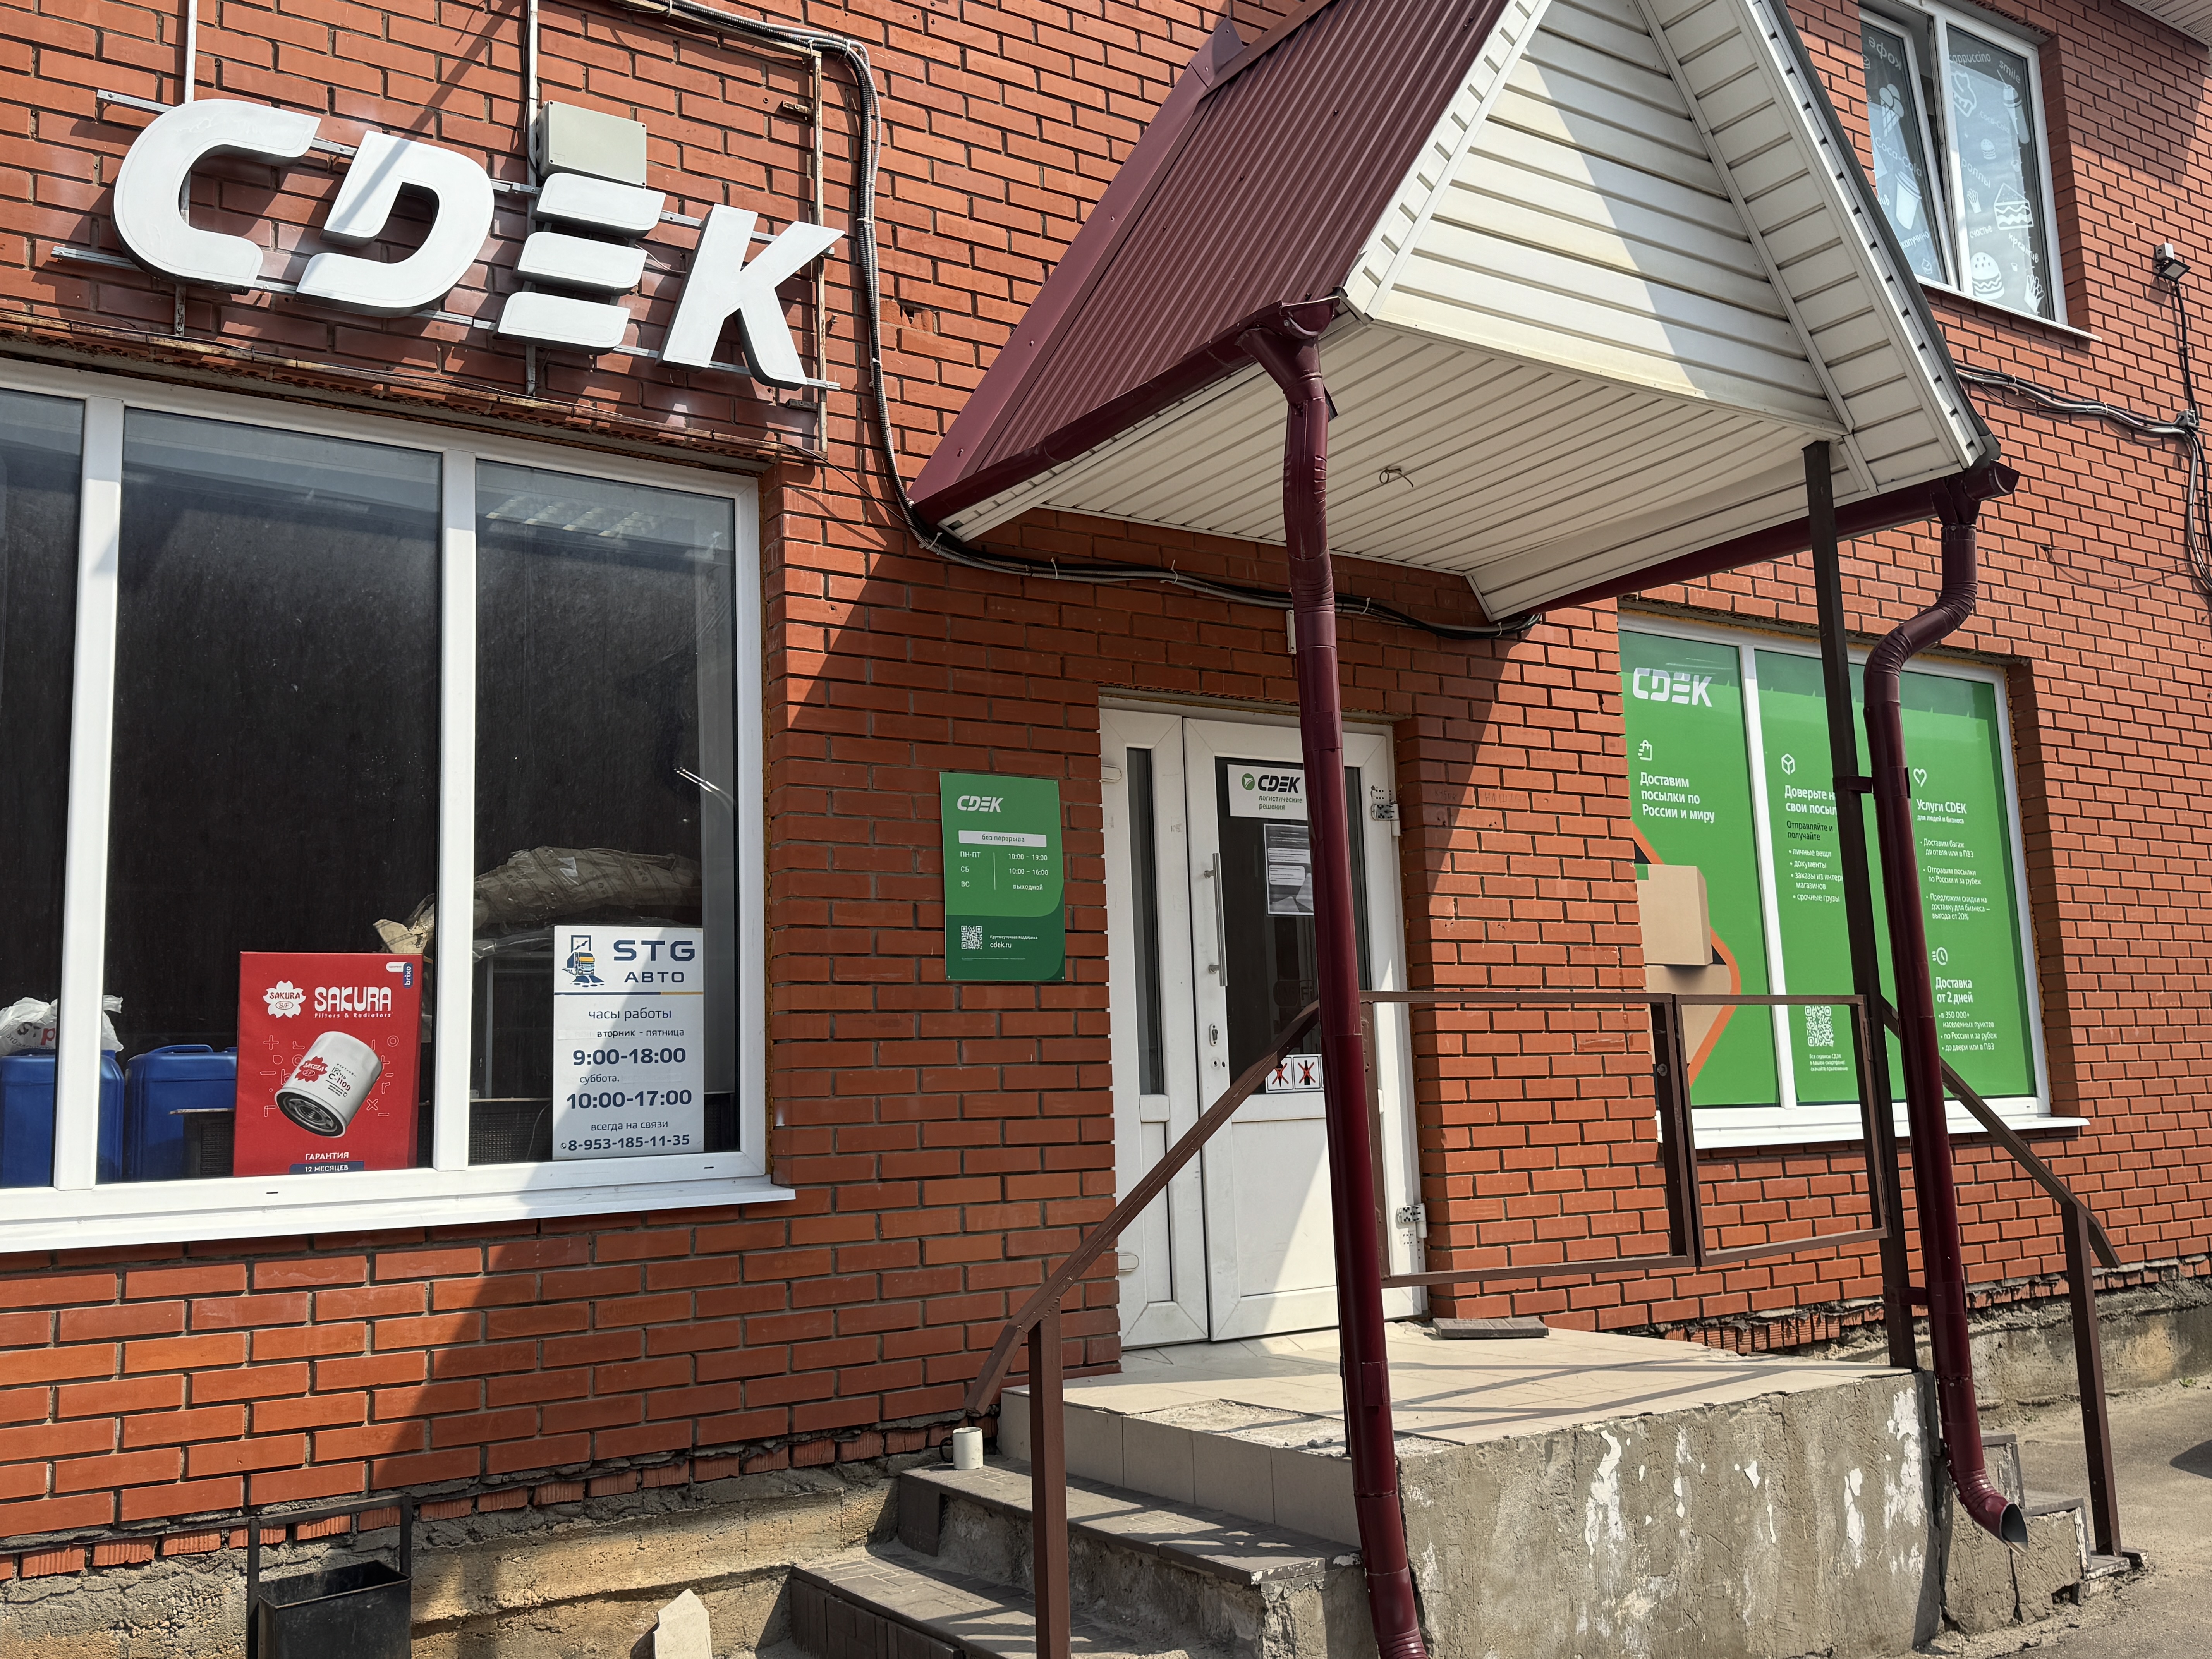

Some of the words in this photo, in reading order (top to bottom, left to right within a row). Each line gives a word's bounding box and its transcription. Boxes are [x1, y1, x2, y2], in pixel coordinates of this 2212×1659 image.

[1999, 60, 2021, 84] smile
[1875, 137, 1922, 177] Coca-Cola
[1961, 158, 1991, 189] роллы
[1969, 225, 1993, 239] счастье
[112, 98, 845, 390] CDEK
[1900, 231, 1930, 249] капучино
[2008, 232, 2039, 263] креатив
[1632, 667, 1712, 707] CDEK
[1258, 775, 1301, 793] CDEK
[1640, 772, 1689, 788] Доставим
[1641, 790, 1685, 803] посылки
[1688, 795, 1700, 804] по
[1784, 785, 1827, 801] Доверьте
[957, 795, 1004, 813] CDEK
[1786, 802, 1807, 813] свои
[1809, 804, 1837, 816] посыл
[1916, 799, 1944, 813] Услуги
[1945, 802, 1967, 814] CDEK
[1642, 803, 1678, 818] России
[1680, 809, 1687, 819] и
[1690, 810, 1715, 824] миру
[1787, 820, 1828, 831] Отправляйте
[1788, 832, 1820, 841] получайте
[1924, 838, 1949, 847] Доставим
[1794, 860, 1827, 869] документы
[1927, 866, 1953, 874] Отправим
[1965, 878, 1982, 886] рубеж
[1932, 904, 1954, 912] доставку
[1958, 912, 1969, 921] 20%
[613, 940, 695, 962] STG
[624, 971, 684, 983] АВТО
[1936, 977, 1972, 990] Доставка
[314, 986, 392, 1012] SAKURA
[1937, 994, 1946, 1003] от
[1947, 991, 1952, 1003] 2
[1953, 991, 1973, 1005] дней
[588, 1011, 620, 1019] часы
[624, 1007, 672, 1021] работы
[597, 1030, 635, 1038] вторник
[1982, 1031, 1997, 1041] рубеж
[573, 1048, 686, 1065] 9:00-18:00
[580, 1074, 620, 1085] суббота,
[567, 1089, 692, 1109] 10:00-17:00
[591, 1123, 623, 1132] всегда
[568, 1134, 690, 1151] 8-953-185-11-35
[305, 1152, 349, 1160] ГАРАНТИЯ
